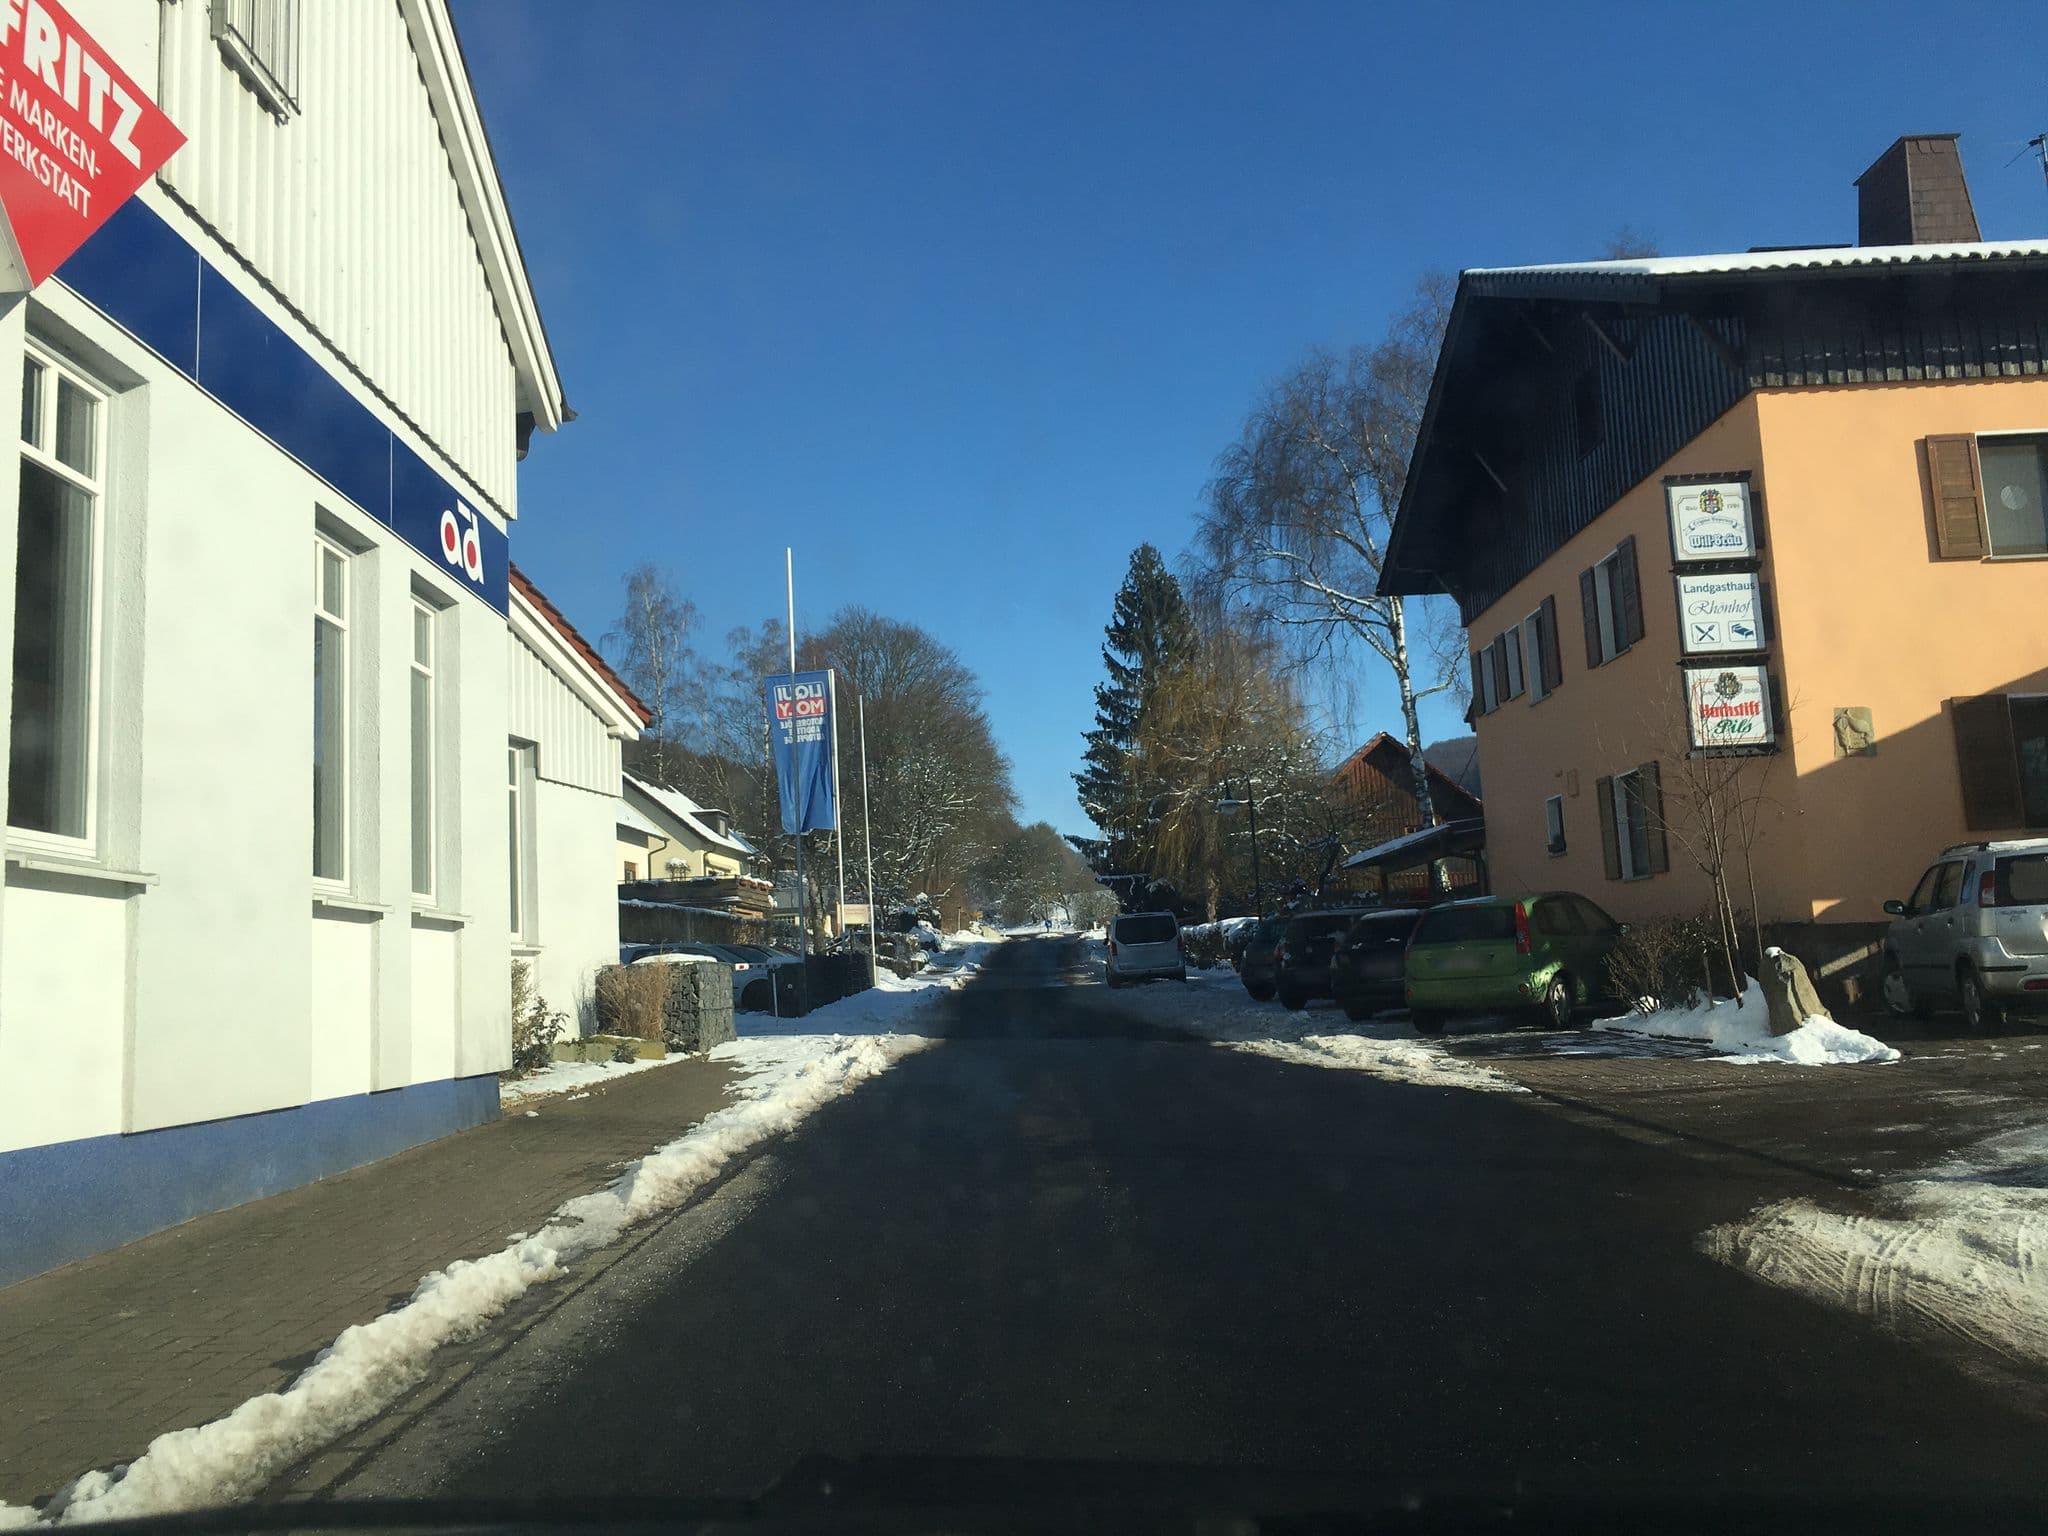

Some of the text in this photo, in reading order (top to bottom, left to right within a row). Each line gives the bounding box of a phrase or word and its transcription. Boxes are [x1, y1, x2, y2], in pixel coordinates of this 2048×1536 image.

[9, 79, 101, 179] MARKEN-
[0, 115, 91, 218] ERKSTATT
[1683, 582, 1756, 594] Landgasthaus
[1714, 719, 1752, 734] Pils
